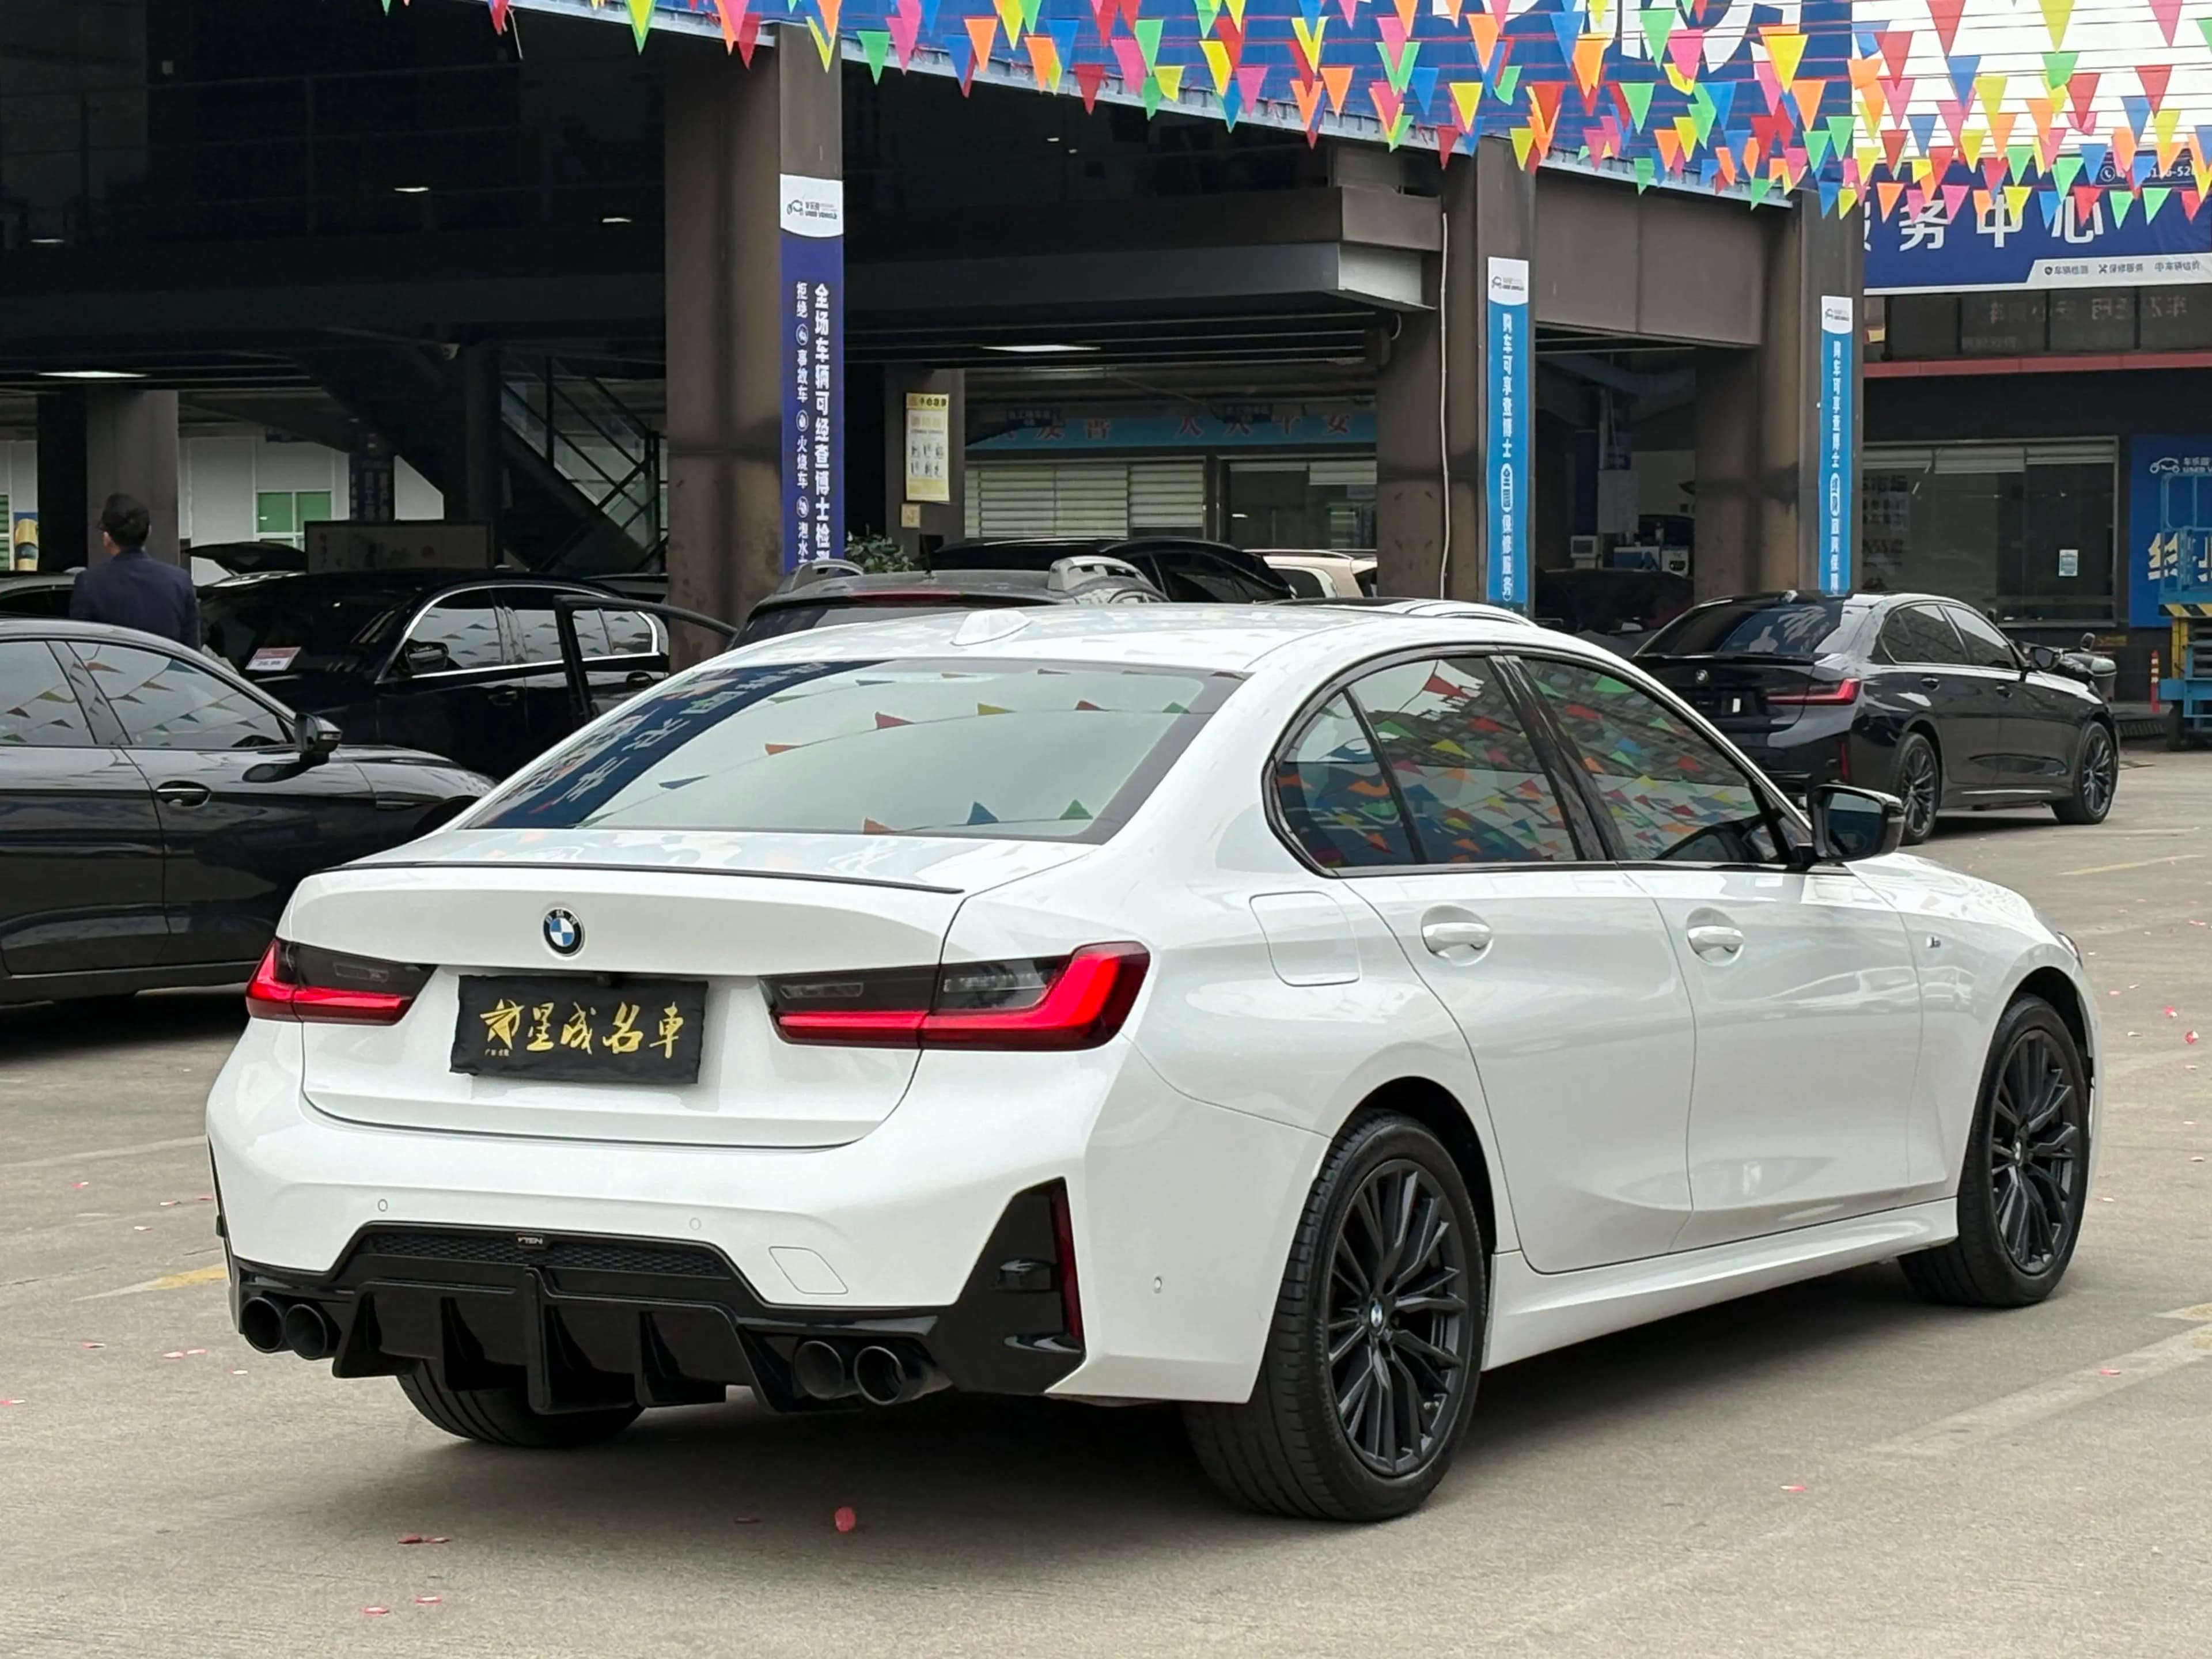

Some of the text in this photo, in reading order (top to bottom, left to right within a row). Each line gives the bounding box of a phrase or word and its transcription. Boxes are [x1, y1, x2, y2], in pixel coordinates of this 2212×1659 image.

[796, 349, 808, 403] 事故车
[796, 435, 808, 490] 火烧车
[797, 522, 808, 564] 泡水
